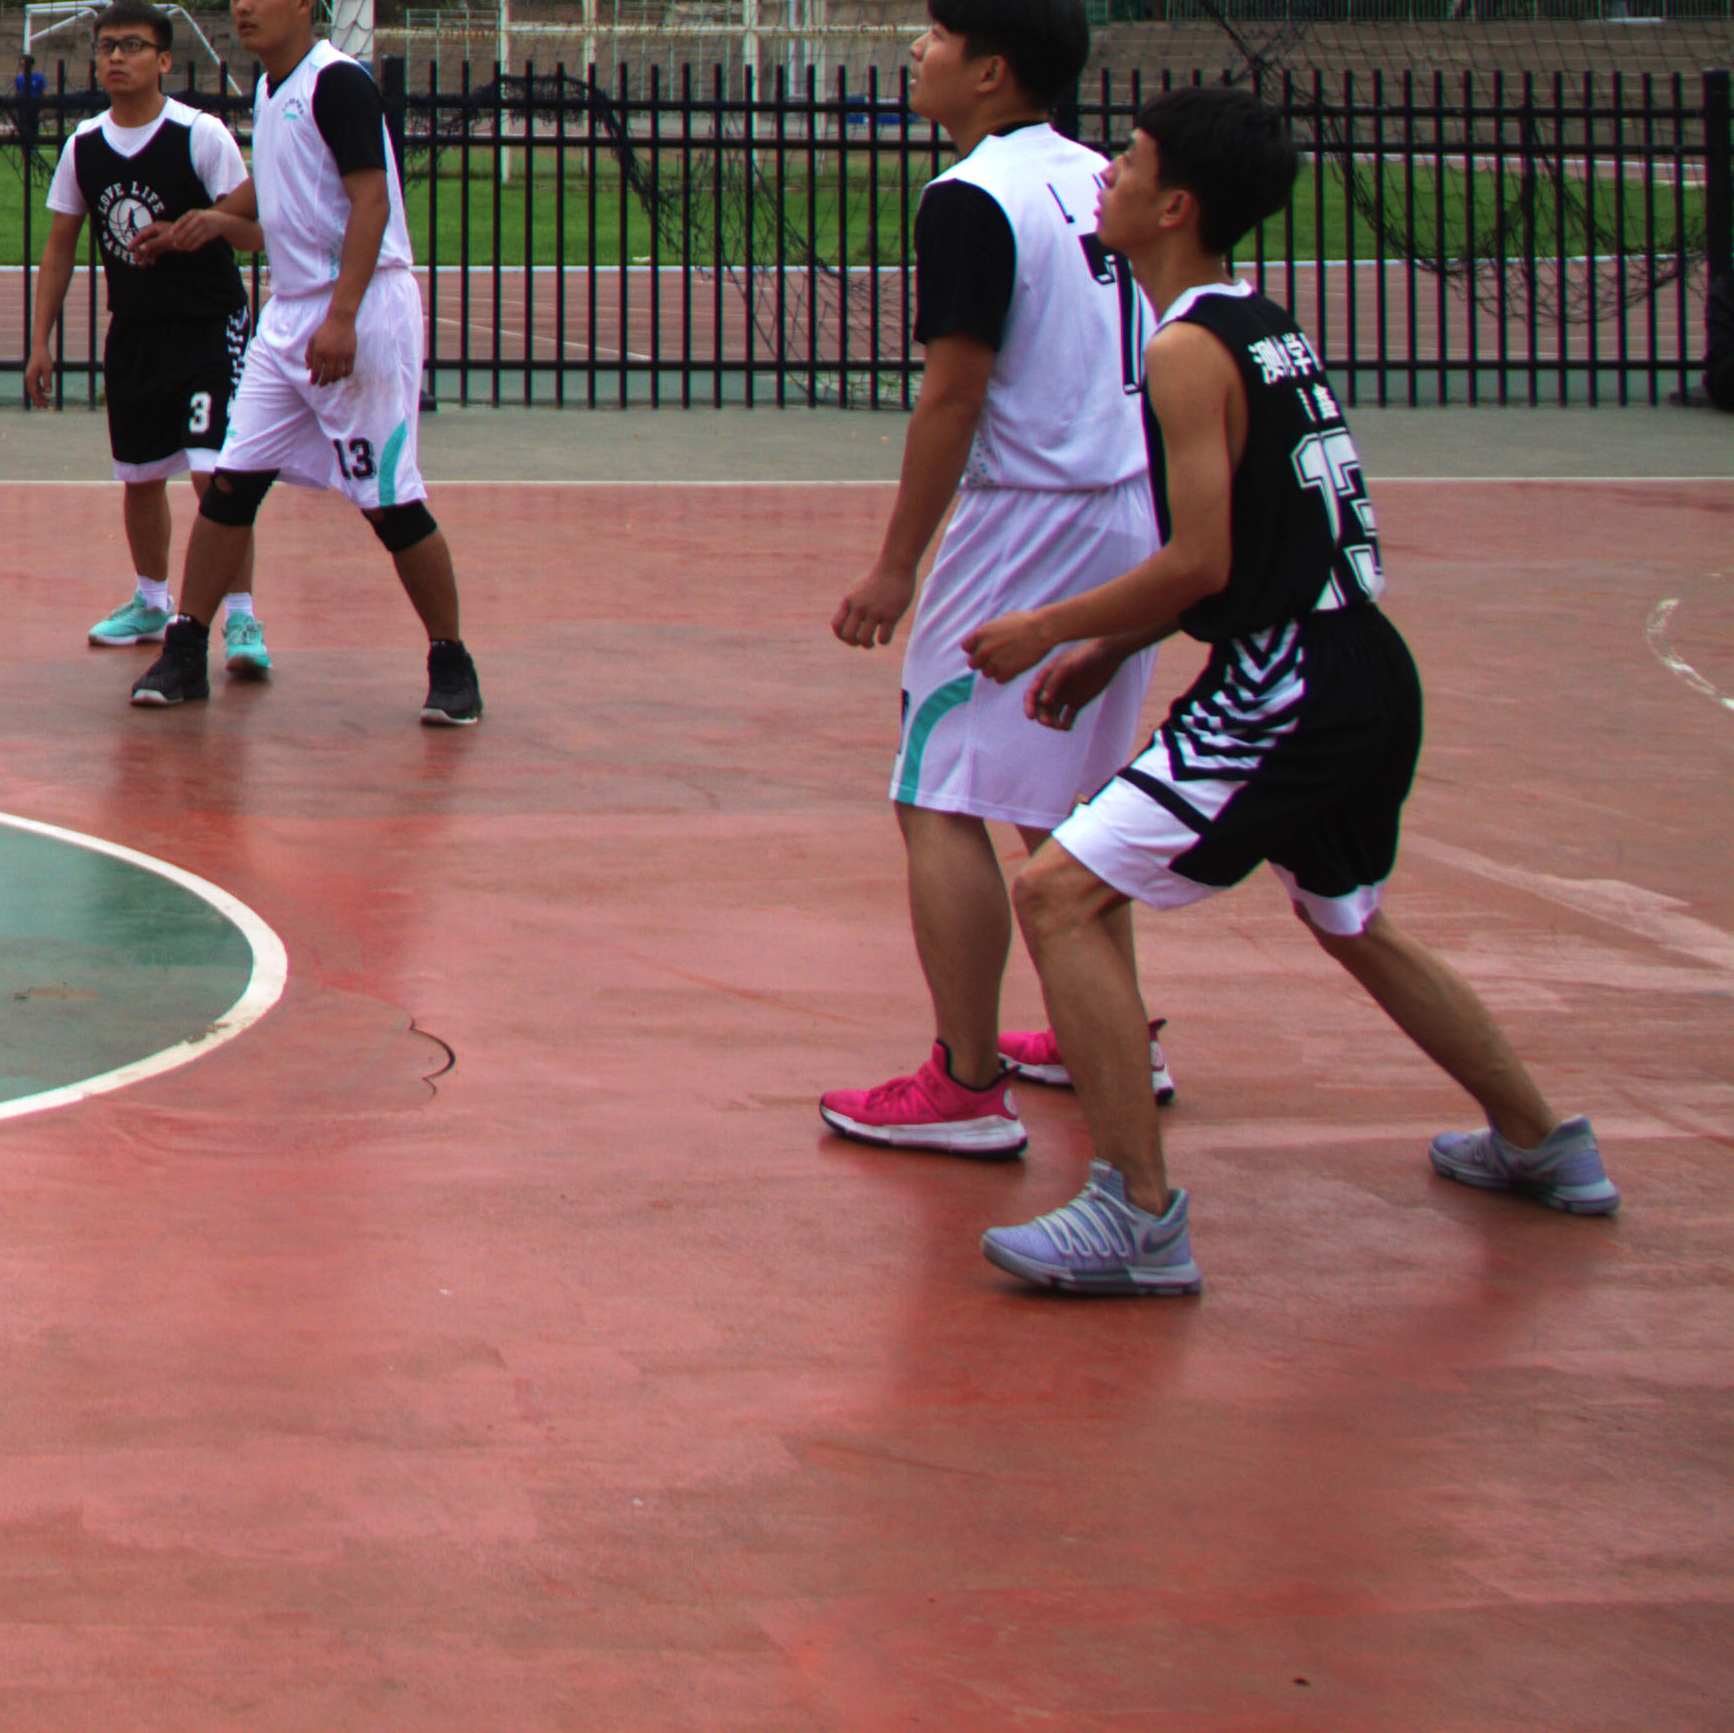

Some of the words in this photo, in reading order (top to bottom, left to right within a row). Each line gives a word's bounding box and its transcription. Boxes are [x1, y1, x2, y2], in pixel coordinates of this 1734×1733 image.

[98, 181, 126, 215] LOVE
[130, 179, 167, 215] LIFE
[188, 390, 213, 435] 3
[331, 436, 377, 482] 13
